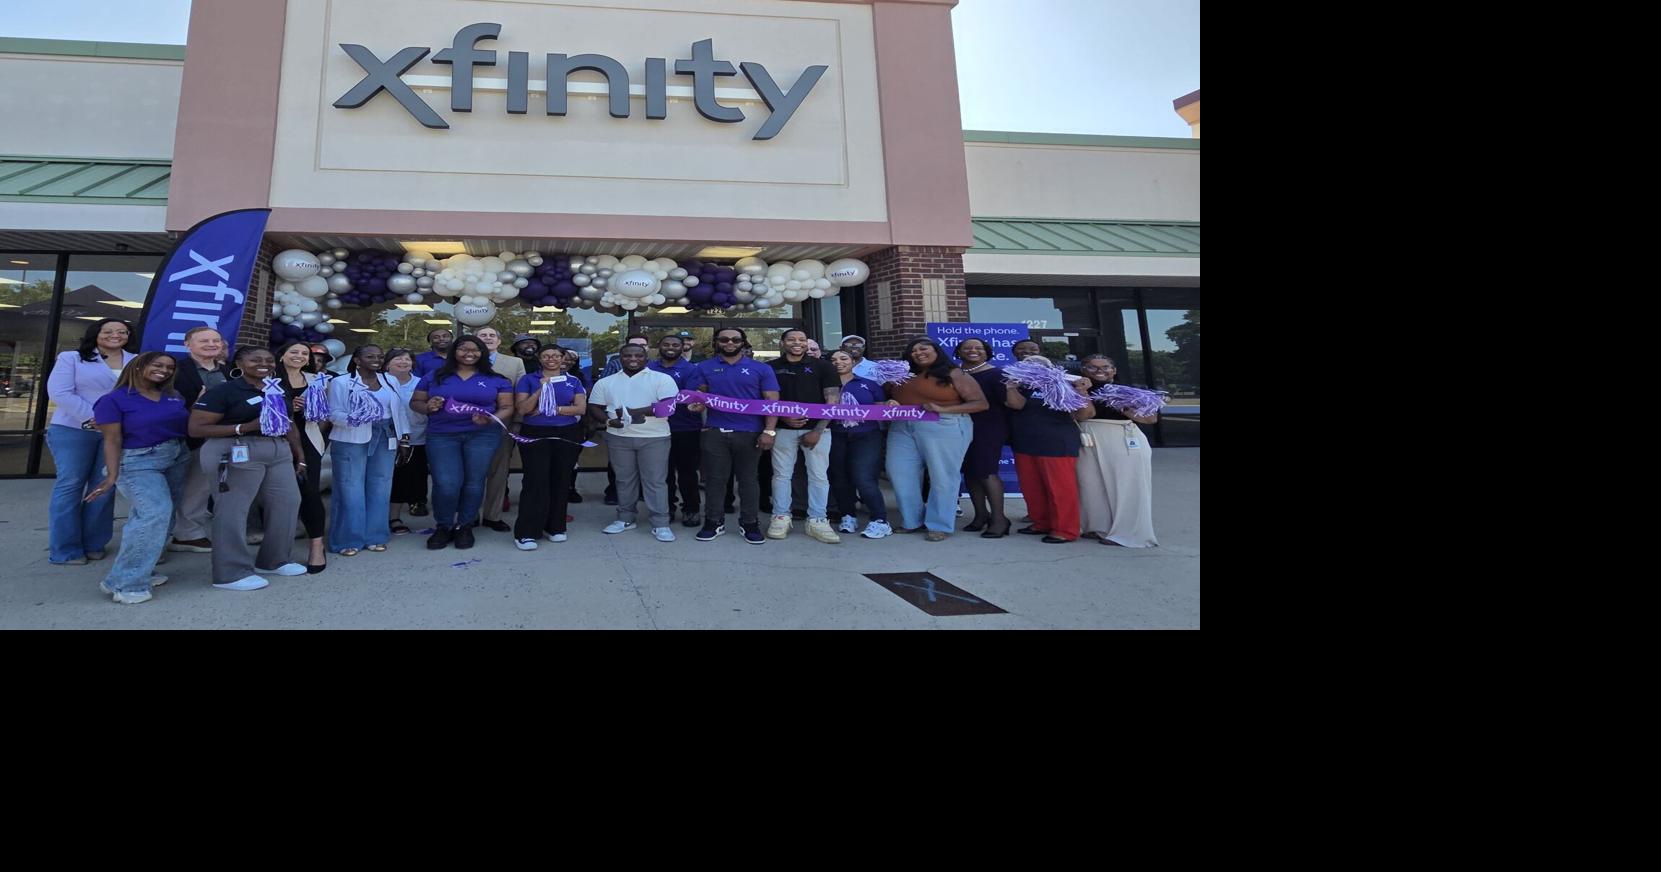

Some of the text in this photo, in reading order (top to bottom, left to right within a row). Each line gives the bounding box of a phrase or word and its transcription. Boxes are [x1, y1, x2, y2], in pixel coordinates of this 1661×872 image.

[333, 23, 829, 140] xfinity
[625, 280, 649, 288] xfinity
[937, 327, 1020, 336] Hold the phone.
[705, 396, 749, 413] xfinity
[761, 402, 809, 417] xfinity
[821, 405, 871, 419] xfinity
[882, 407, 926, 419] xfinity
